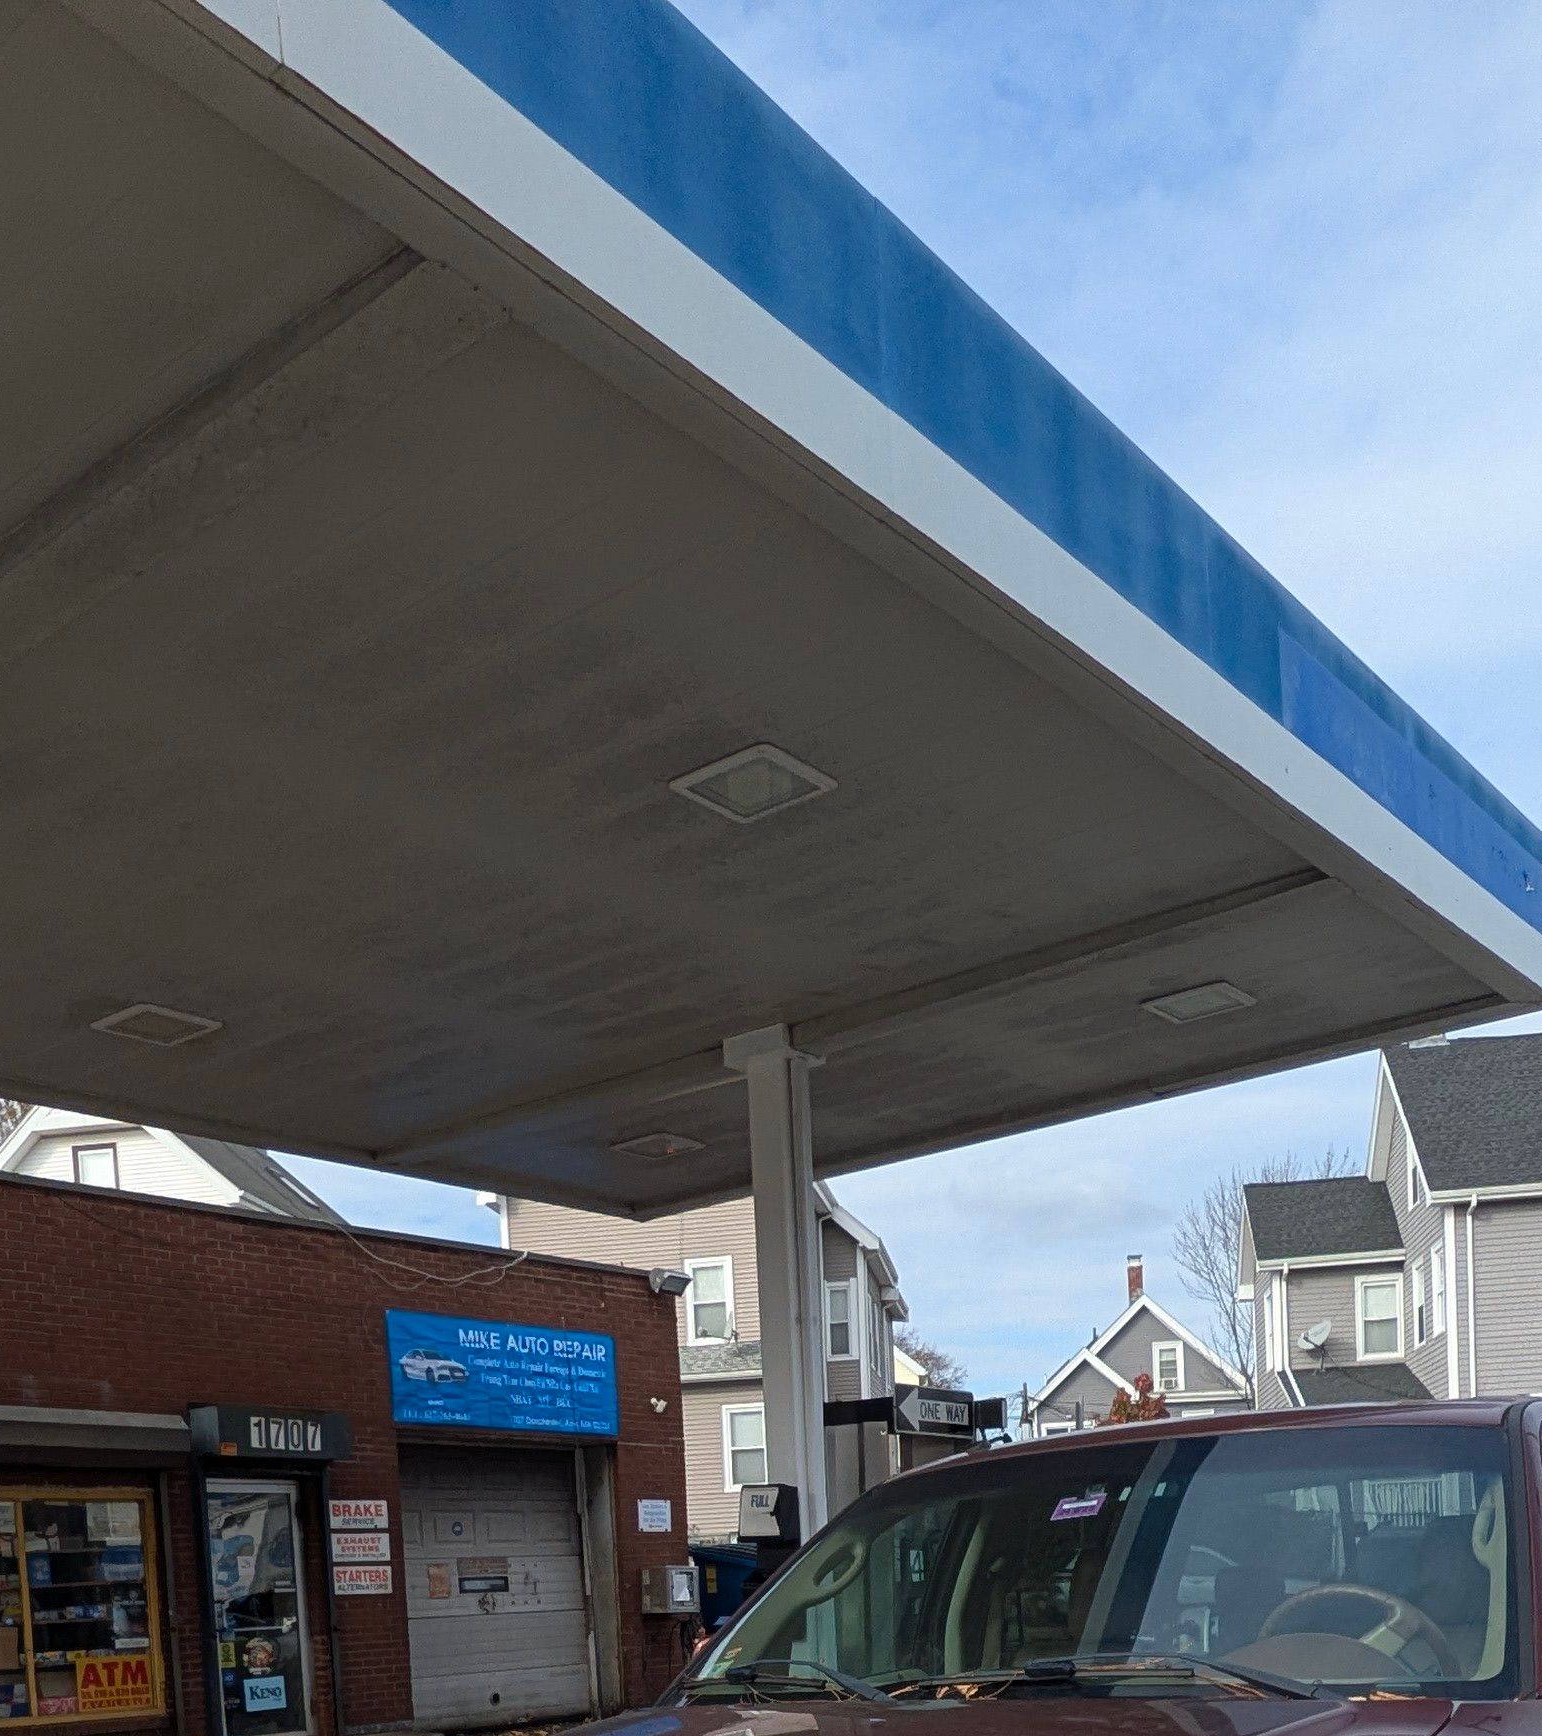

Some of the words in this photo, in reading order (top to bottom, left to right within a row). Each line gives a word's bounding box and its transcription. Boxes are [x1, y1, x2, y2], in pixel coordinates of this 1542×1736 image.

[458, 1328, 501, 1351] MIKE
[507, 1334, 549, 1356] AUTO
[553, 1339, 607, 1362] REPAIR
[919, 1402, 940, 1420] ONE
[945, 1404, 967, 1423] WAY
[252, 1417, 321, 1450] 1707
[331, 1503, 384, 1517] BRAKE
[750, 1494, 770, 1508] FULL
[335, 1570, 389, 1583] STARTERS
[80, 1659, 150, 1690] ATM
